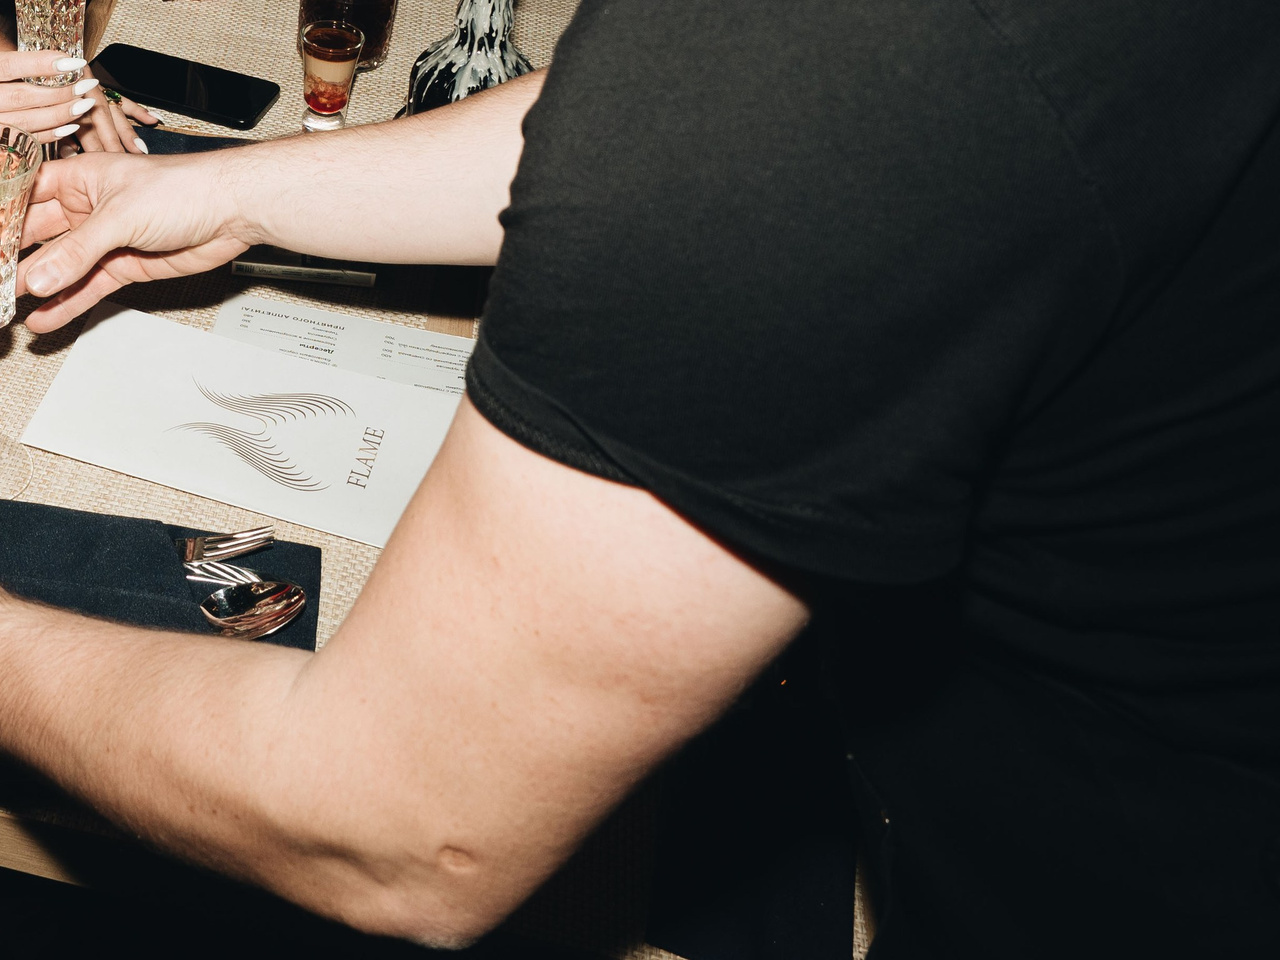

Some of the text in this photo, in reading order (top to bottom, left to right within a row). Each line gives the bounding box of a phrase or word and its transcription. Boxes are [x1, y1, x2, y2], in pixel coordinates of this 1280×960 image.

[241, 306, 345, 331] ПРИЯТНОГО АППЕТИТА!
[299, 342, 335, 355] Десерты
[346, 426, 385, 490] FLAME
